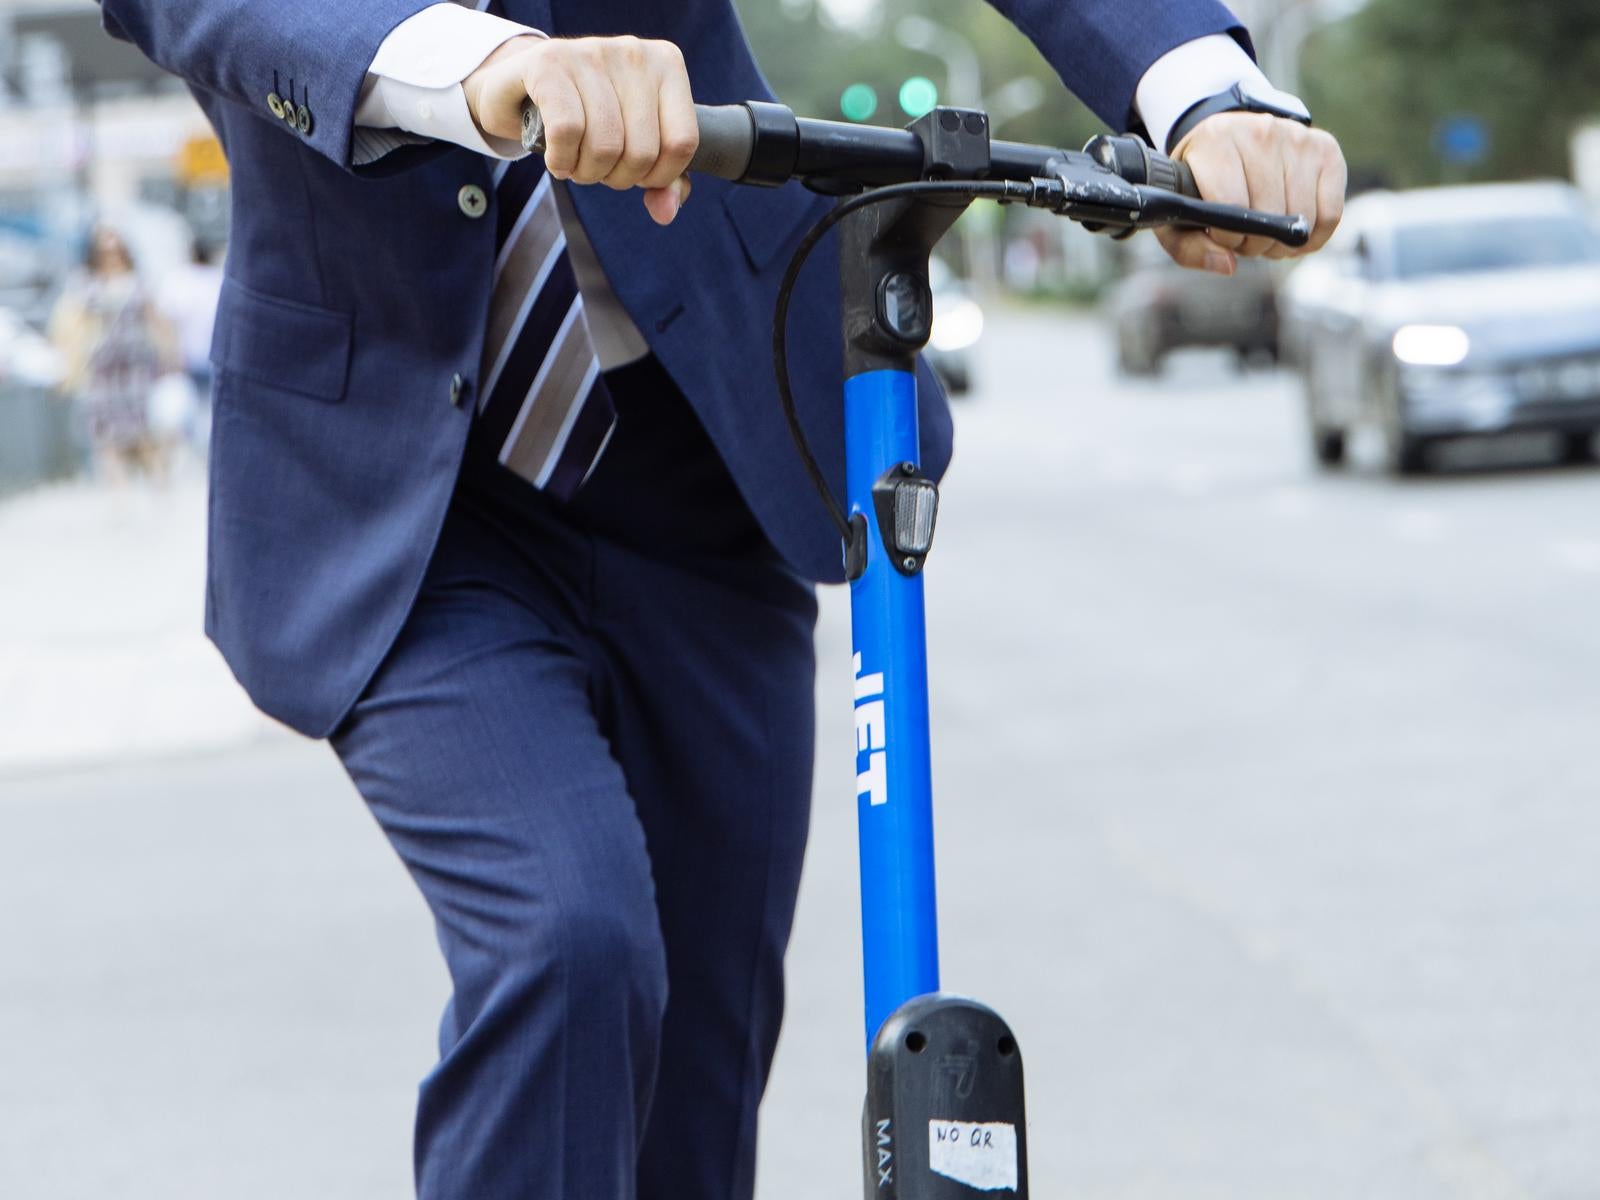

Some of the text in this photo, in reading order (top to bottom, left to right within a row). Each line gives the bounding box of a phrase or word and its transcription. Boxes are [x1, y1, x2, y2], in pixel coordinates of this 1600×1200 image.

[852, 650, 887, 806] JET
[876, 1118, 892, 1187] MAX
[937, 1127, 993, 1149] NO QR
